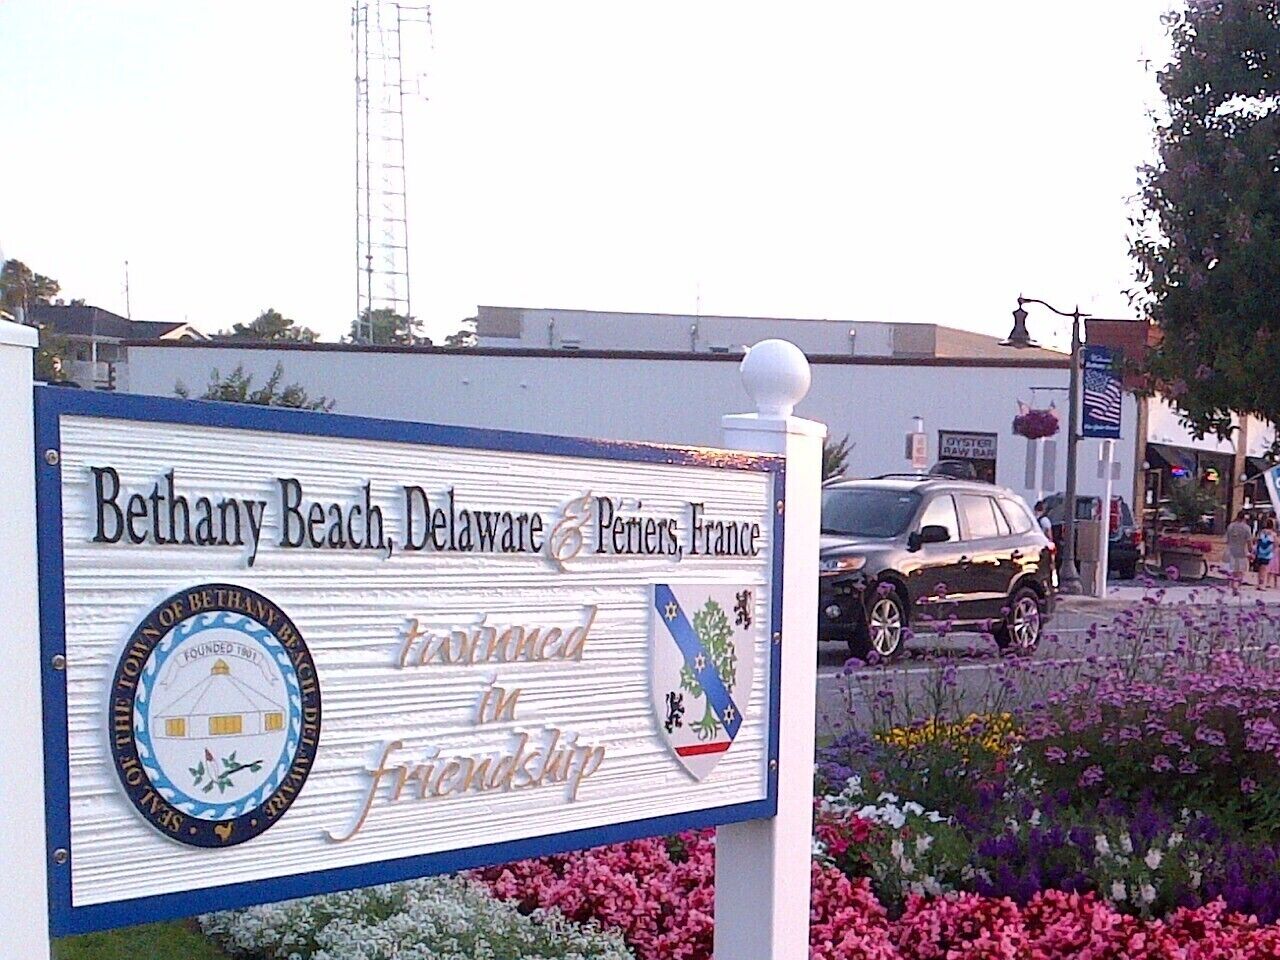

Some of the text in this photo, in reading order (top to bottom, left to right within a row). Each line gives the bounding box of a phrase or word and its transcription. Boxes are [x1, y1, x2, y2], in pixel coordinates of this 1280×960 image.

[943, 447, 995, 457] RAW BAR
[945, 437, 992, 448] OYSTER
[91, 466, 267, 567] Bethany
[276, 477, 394, 559] Beach,
[403, 485, 543, 553] Delaware
[549, 489, 593, 573] &
[686, 501, 761, 557] France
[158, 599, 184, 627] OF
[187, 588, 281, 627] BETHANY
[118, 622, 161, 689] TOWN
[184, 642, 257, 661] FOUNDED 1901
[399, 604, 597, 669] twinned
[480, 672, 522, 724] in
[114, 698, 132, 749] THE
[120, 756, 142, 786] OF
[263, 706, 317, 820] DELAWARE
[323, 728, 606, 843] friendship
[140, 786, 184, 833] SEAL
